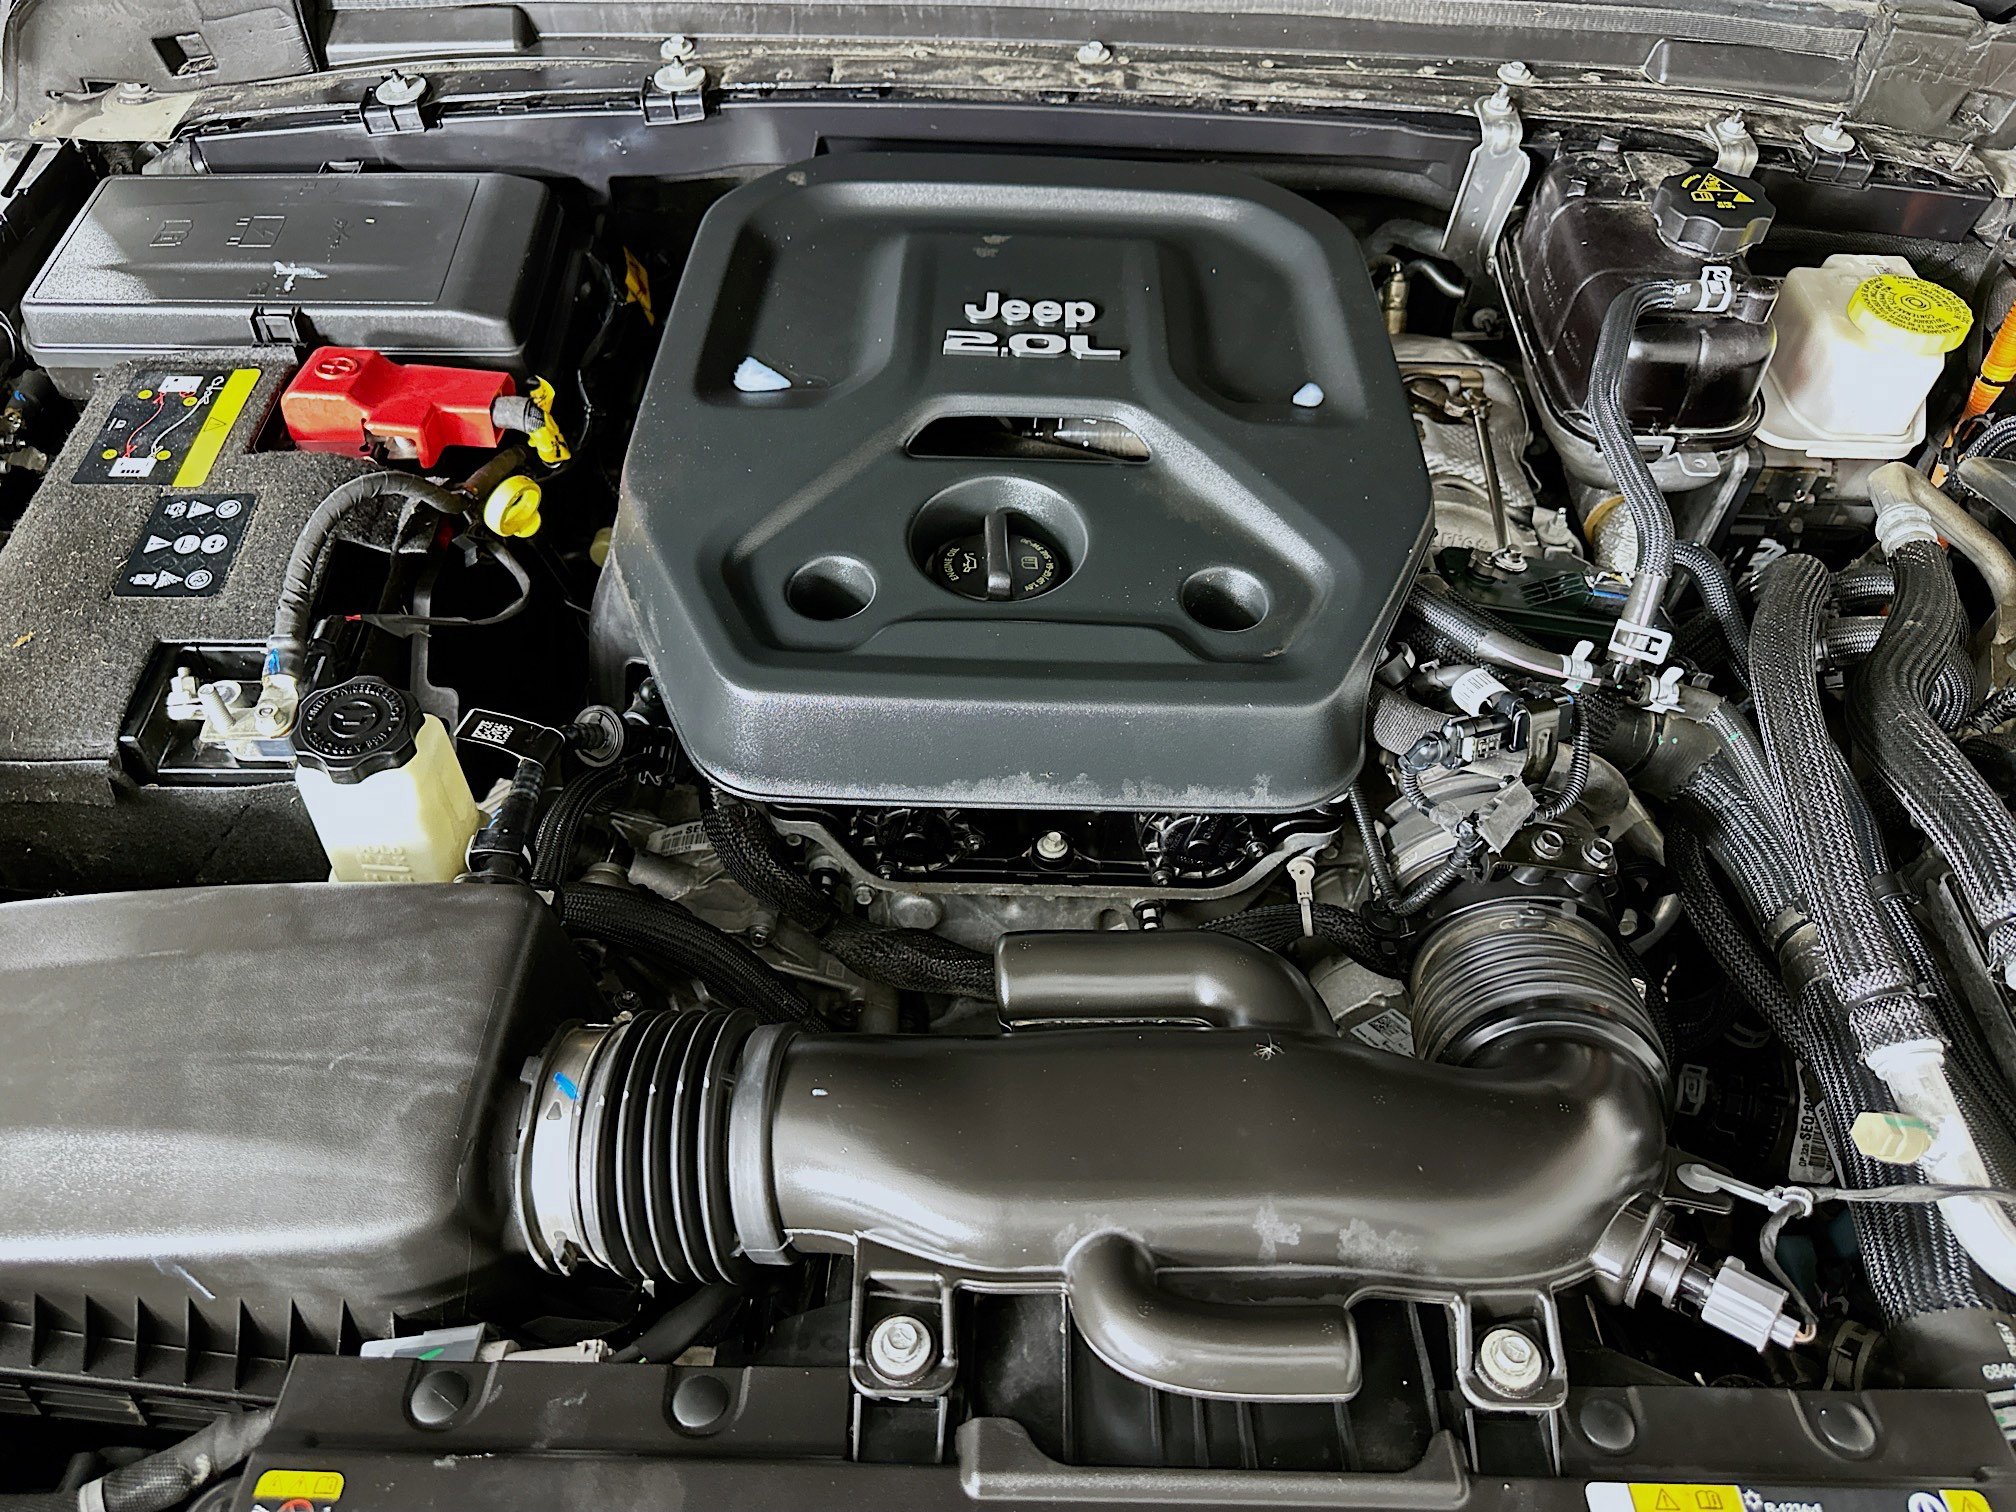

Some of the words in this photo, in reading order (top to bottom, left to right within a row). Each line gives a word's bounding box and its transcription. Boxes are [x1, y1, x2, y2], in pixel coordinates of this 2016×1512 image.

[963, 291, 1097, 330] Jeep
[942, 328, 1122, 361] 2.0L
[946, 547, 961, 557] OIL
[942, 557, 960, 582] ENGINE
